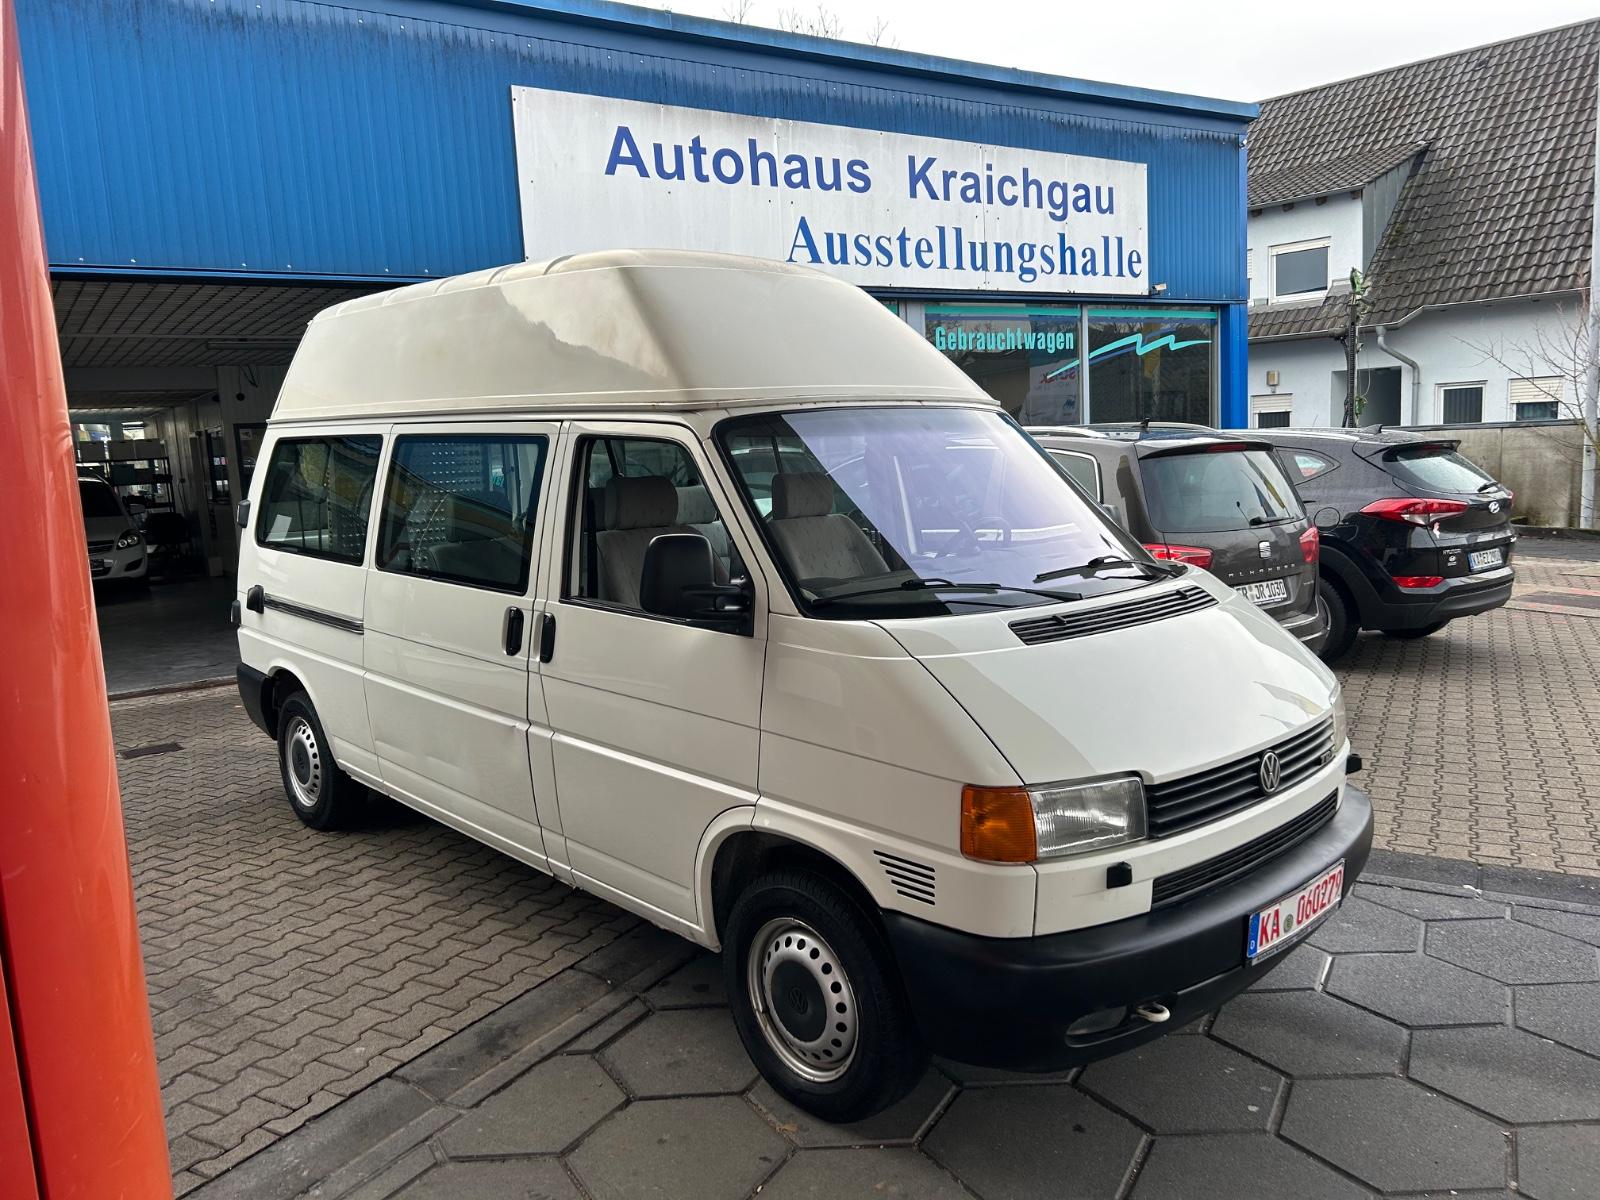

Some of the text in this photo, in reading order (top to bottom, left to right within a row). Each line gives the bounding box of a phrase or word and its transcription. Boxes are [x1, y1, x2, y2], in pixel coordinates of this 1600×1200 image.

[604, 125, 1115, 222] Autohaus Kraichgau
[785, 215, 1143, 284] Ausstellungshalle
[935, 326, 1075, 353] Gebrauchtwagen
[1255, 584, 1267, 600] JR
[1266, 581, 1286, 598] 1030
[1259, 908, 1280, 947] KA
[1296, 869, 1342, 925] 060279
